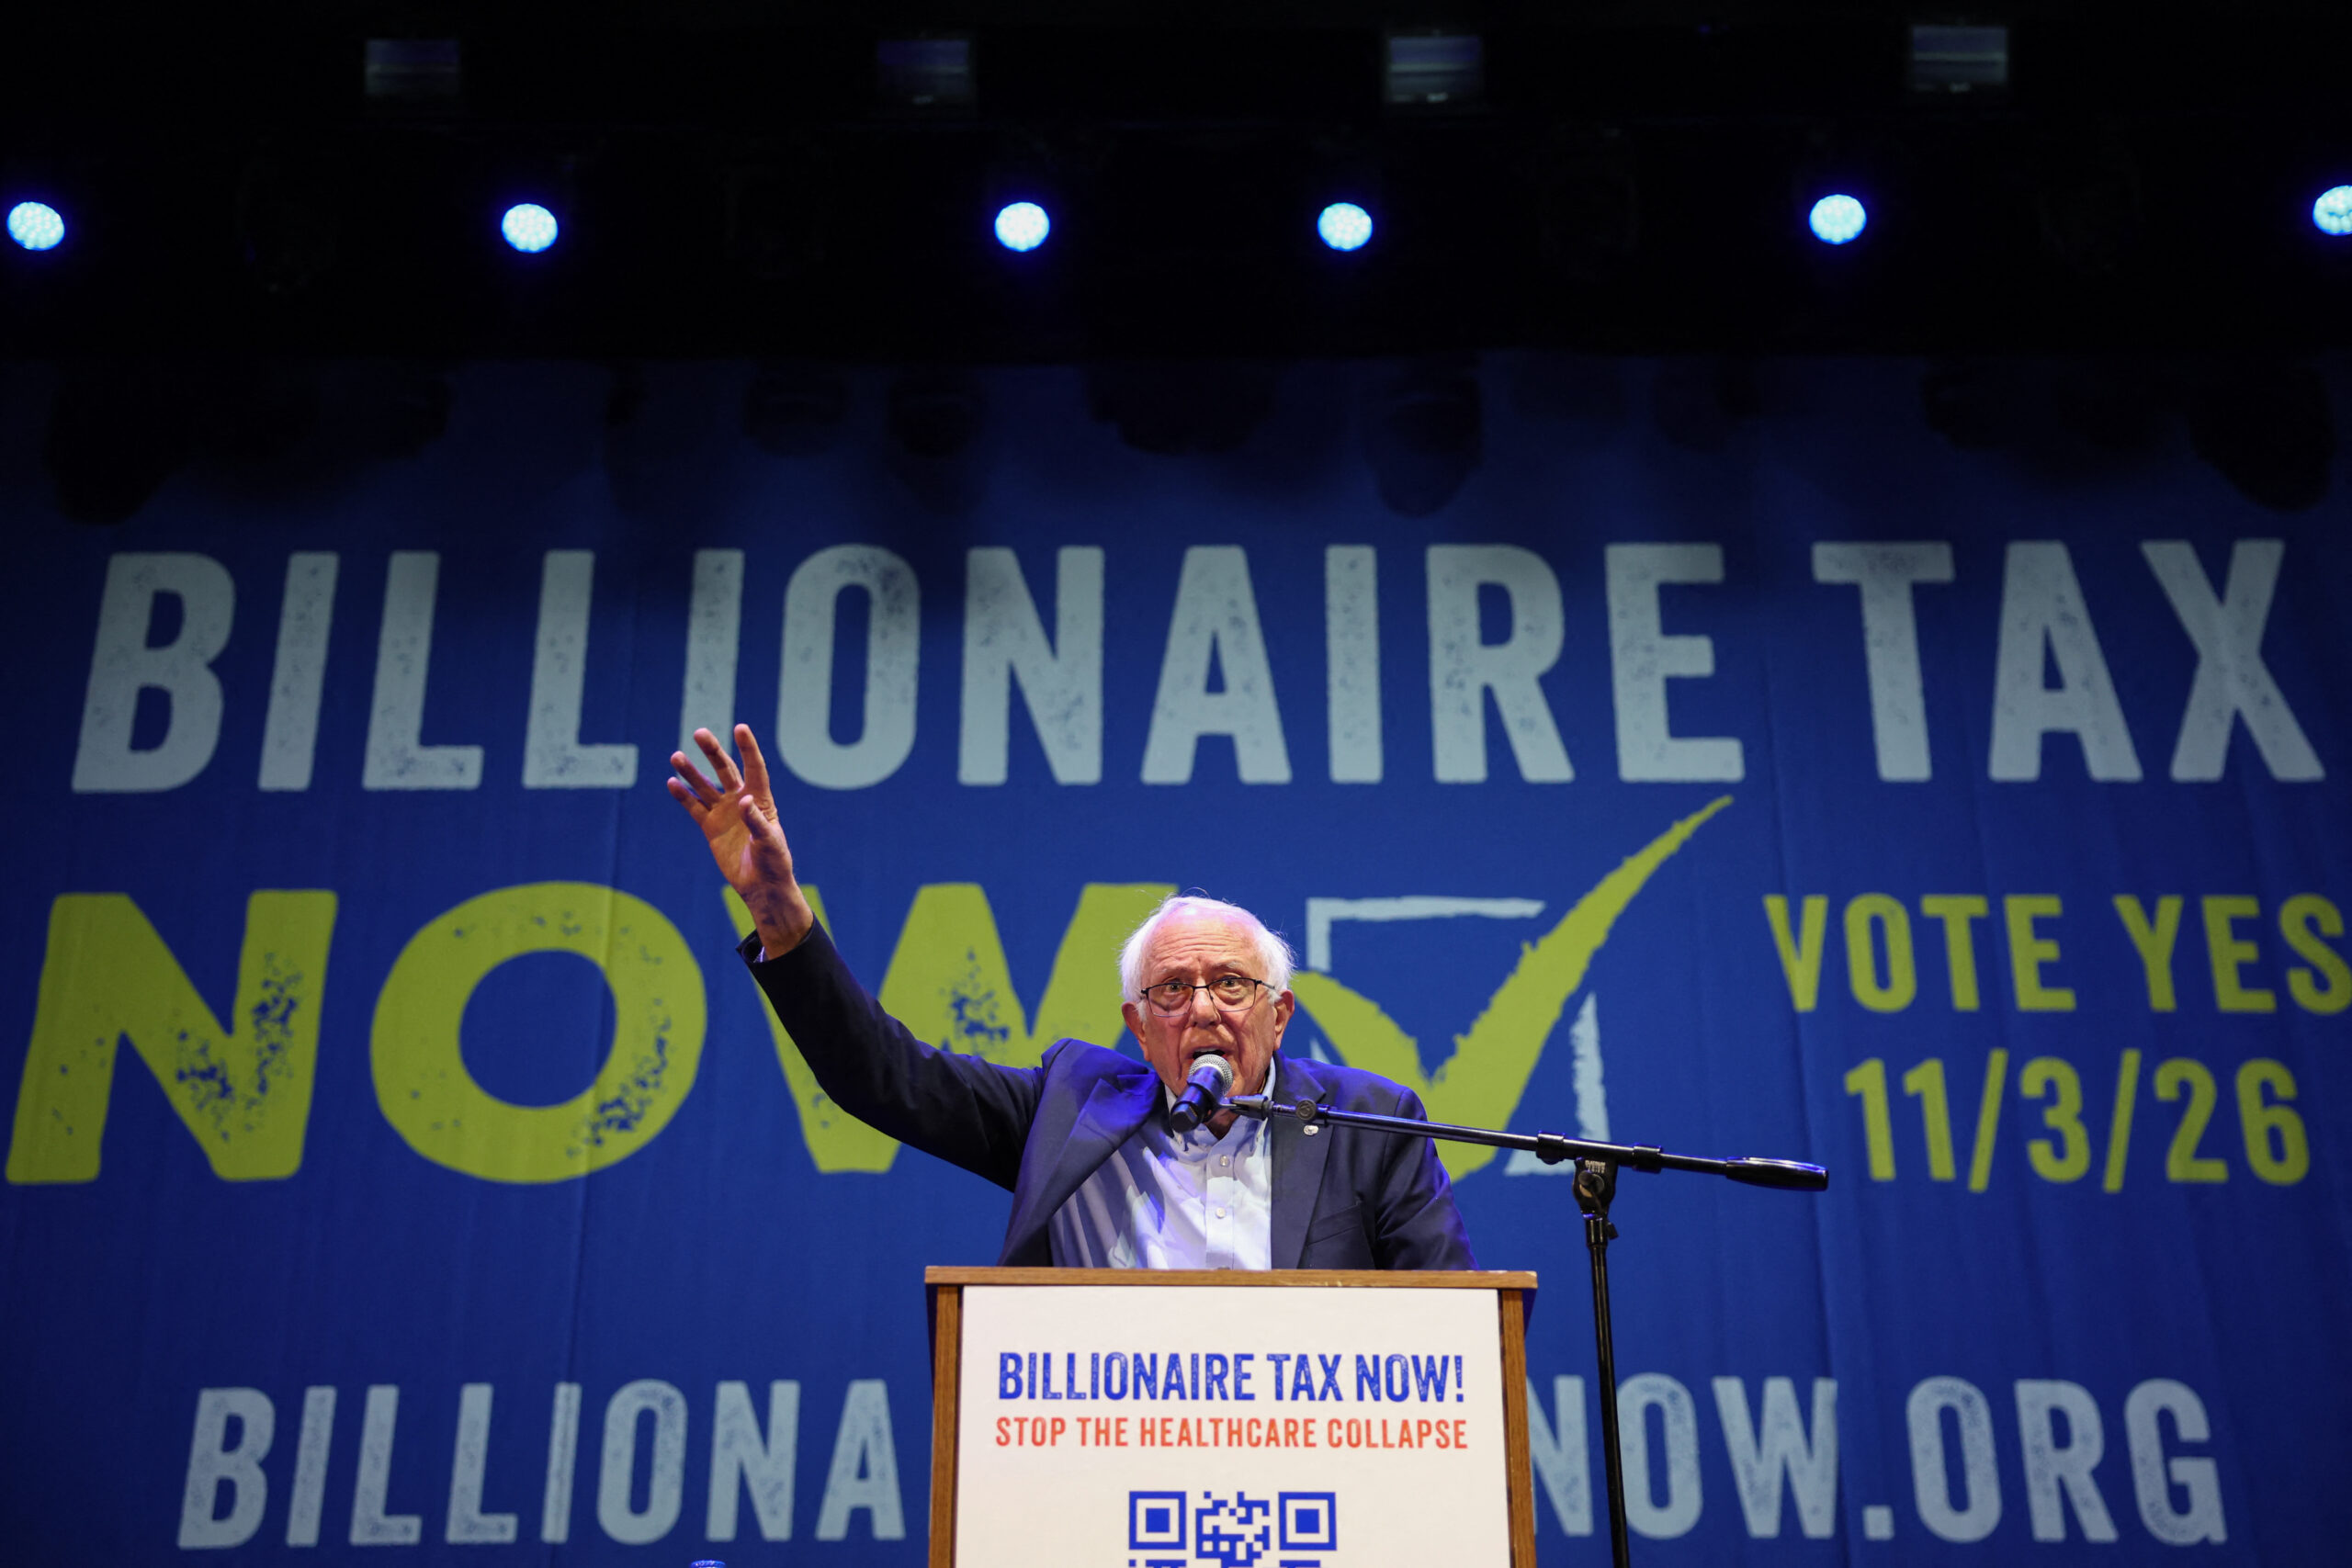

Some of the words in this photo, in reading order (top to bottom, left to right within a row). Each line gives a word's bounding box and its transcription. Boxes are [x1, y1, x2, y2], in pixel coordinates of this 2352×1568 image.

[72, 544, 1744, 793] BILLIONAIRE
[1812, 539, 2326, 783] TAX
[1763, 893, 2076, 1014] VOTE
[2112, 894, 2352, 1015] YES
[5, 880, 1180, 1185] NOW
[1845, 1049, 2311, 1193] 11/3/26
[995, 1416, 1066, 1447] STOP
[1076, 1417, 1128, 1447] THE
[1140, 1417, 1317, 1448] HEALTHCARE
[1327, 1417, 1468, 1449] COLLAPSE
[999, 1351, 1255, 1401] BILLIONAIRE
[1266, 1353, 1343, 1401] TAX
[1355, 1353, 1464, 1403] NOW!
